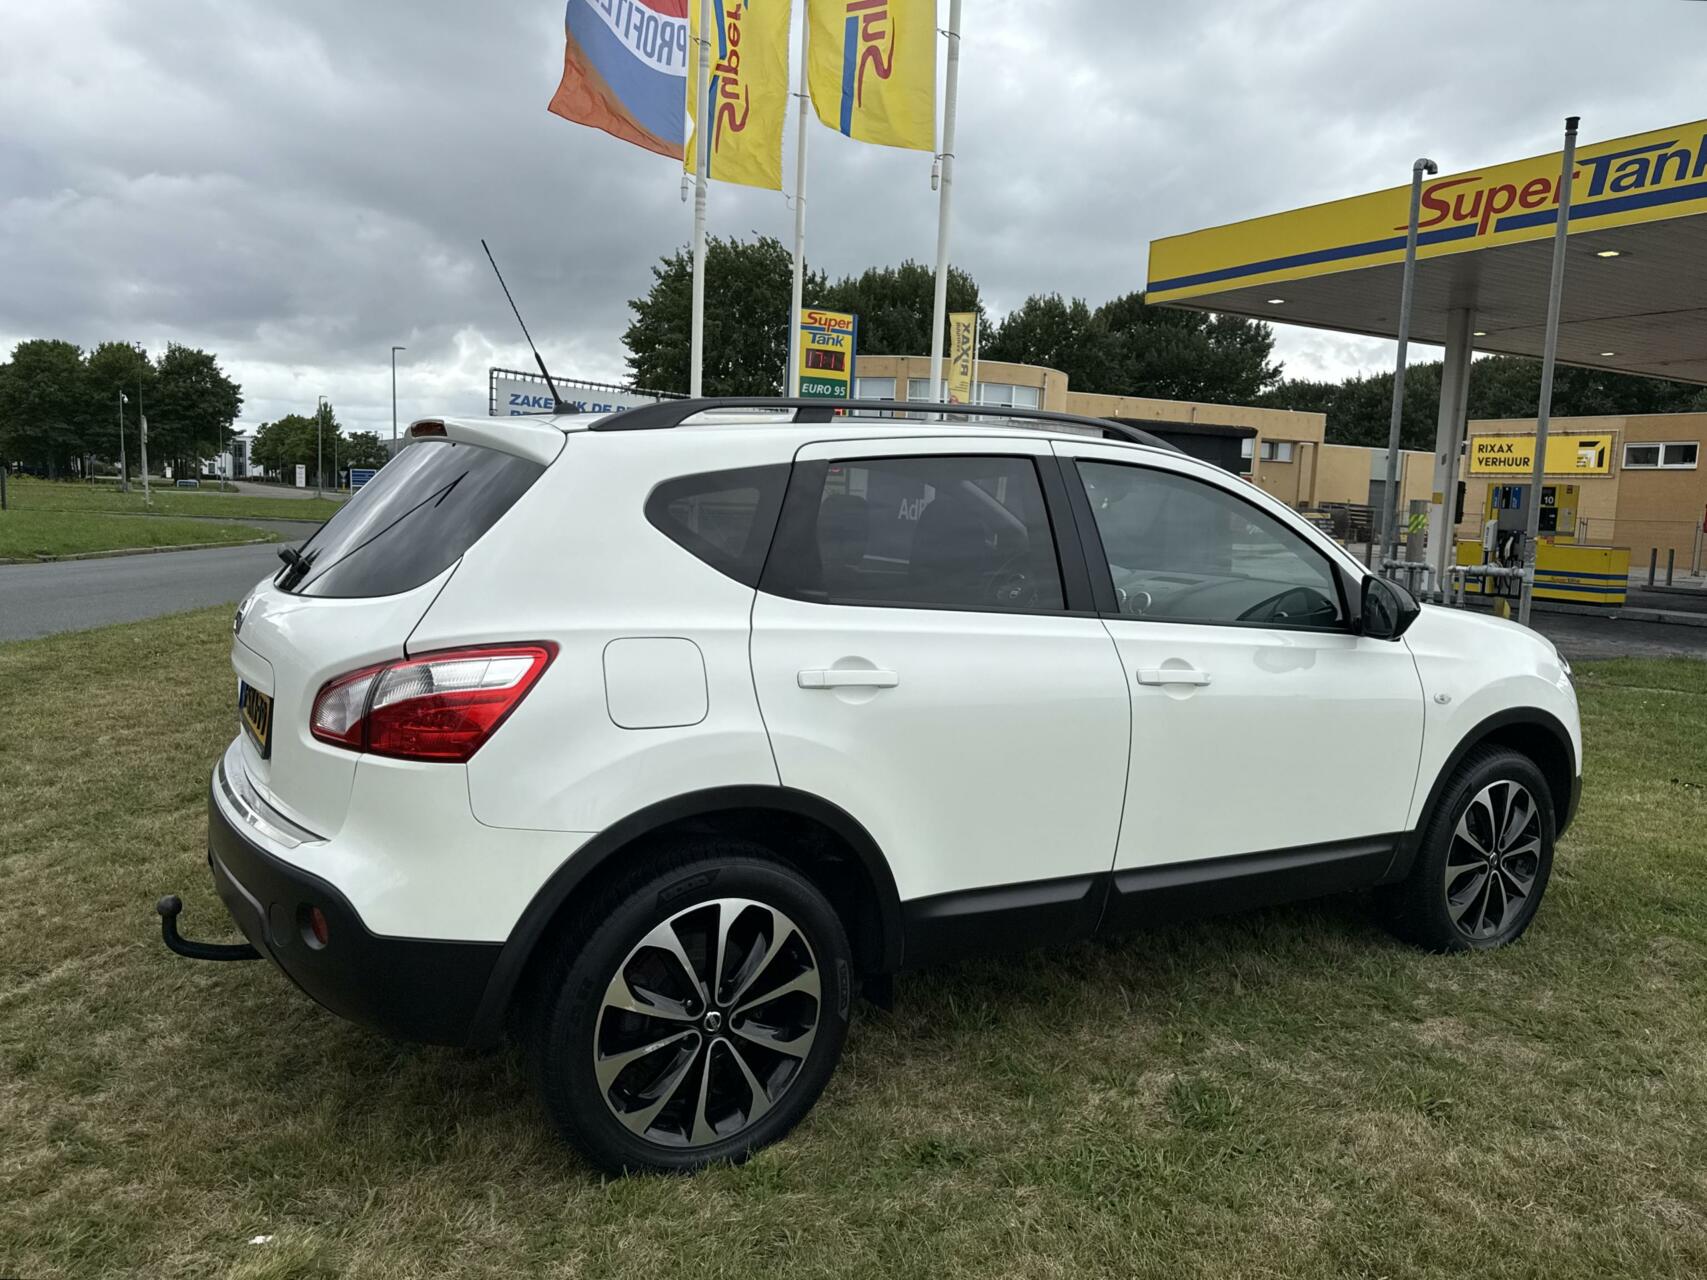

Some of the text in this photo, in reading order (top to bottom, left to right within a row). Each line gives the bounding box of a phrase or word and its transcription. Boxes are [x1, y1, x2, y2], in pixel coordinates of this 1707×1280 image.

[801, 312, 852, 332] Super
[808, 332, 844, 347] Tank
[802, 383, 846, 396] EURO 95
[509, 393, 587, 412] ZAKEK
[592, 403, 612, 413] DE
[1478, 443, 1514, 453] RIXAX
[1478, 457, 1530, 467] VERHUUR
[1544, 496, 1554, 504] 10
